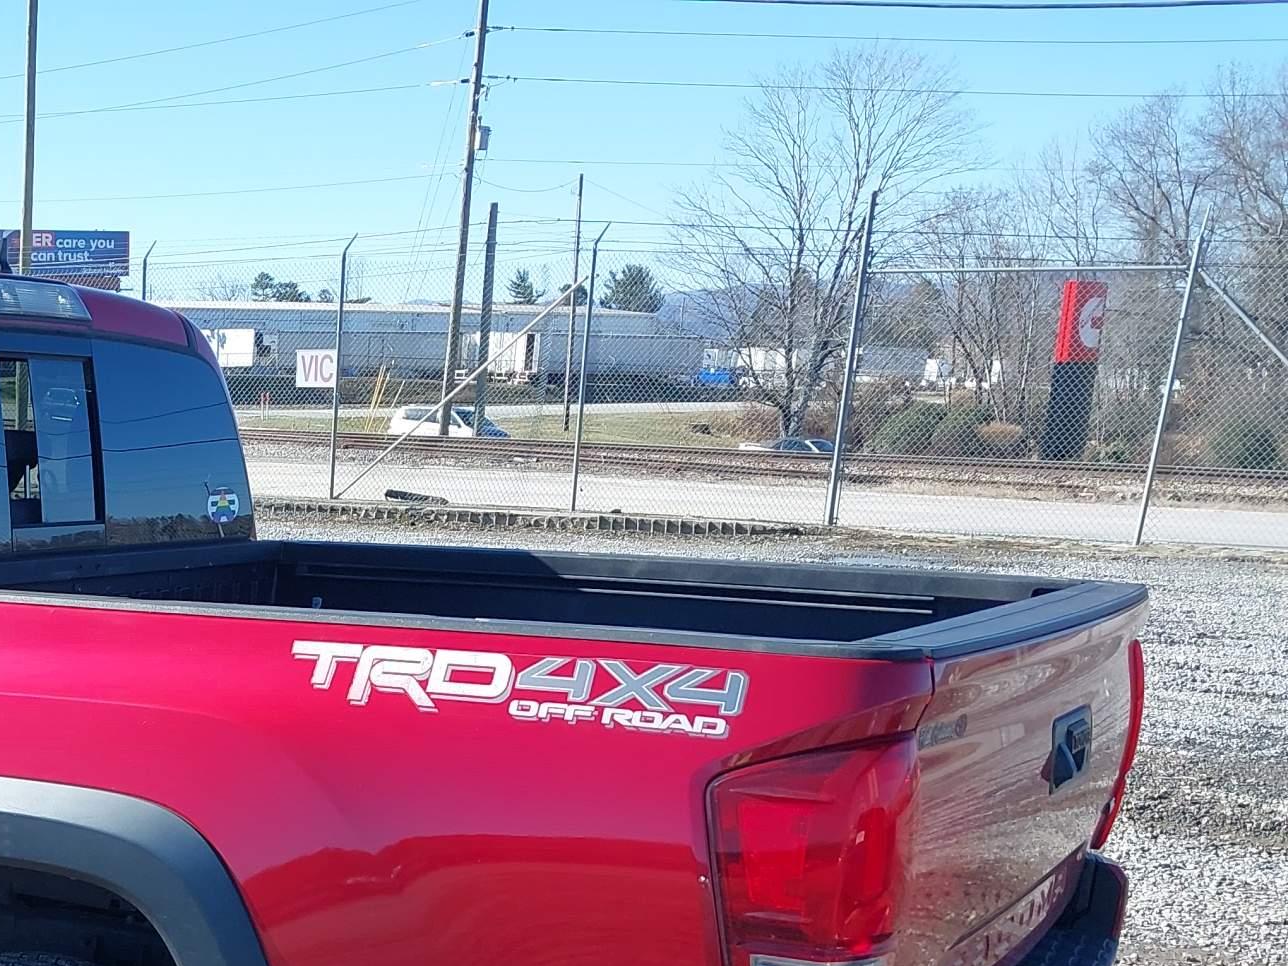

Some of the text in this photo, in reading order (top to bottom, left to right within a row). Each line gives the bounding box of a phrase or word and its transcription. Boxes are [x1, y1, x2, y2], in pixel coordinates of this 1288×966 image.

[30, 251, 55, 261] can
[32, 233, 115, 251] ER care you
[301, 354, 333, 383] VIC
[291, 640, 516, 713] TRD
[508, 699, 729, 739] OFF ROAD
